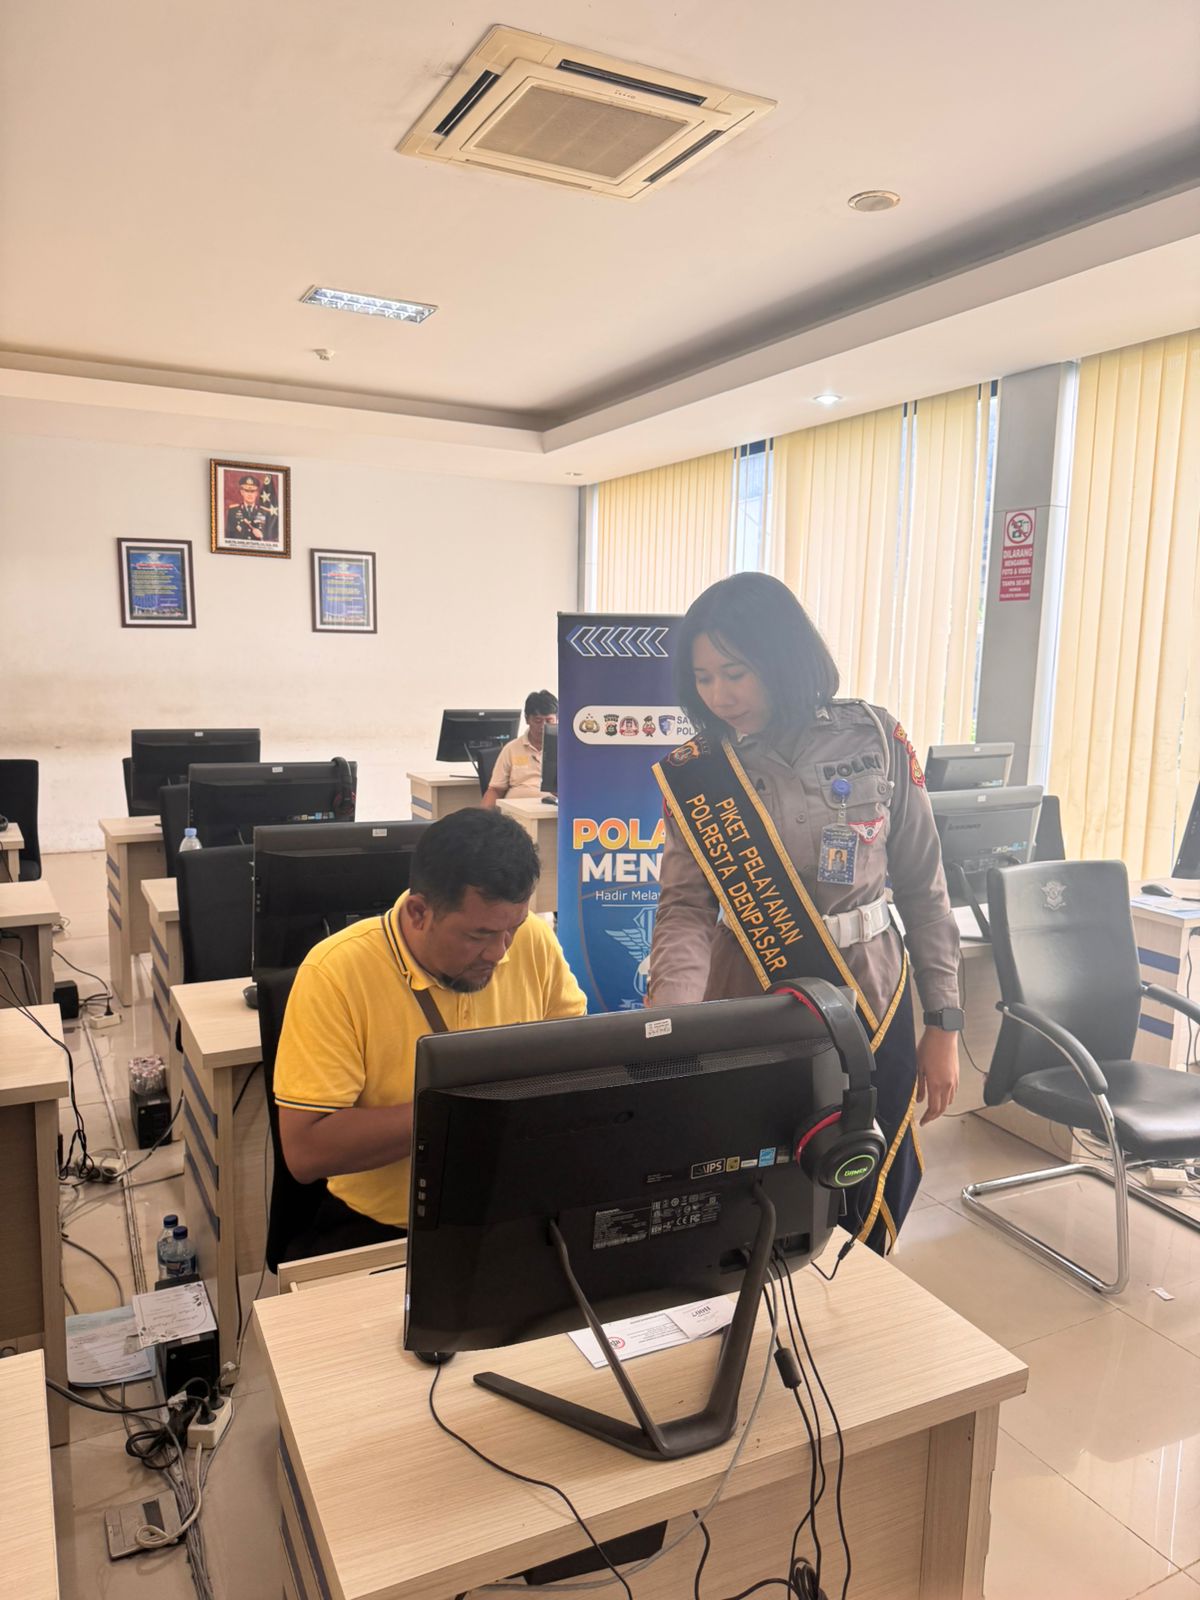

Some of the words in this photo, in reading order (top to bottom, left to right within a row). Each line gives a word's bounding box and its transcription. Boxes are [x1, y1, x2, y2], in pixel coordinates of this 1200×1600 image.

[1003, 548, 1032, 559] DILARANG
[823, 754, 882, 780] POLRI
[582, 853, 663, 882] MEN
[715, 797, 750, 843] PIKET
[739, 846, 803, 946] PELAYANAN
[595, 890, 628, 901] Hadir
[686, 793, 738, 880] POLRESTA
[728, 881, 788, 972] DENPASAR
